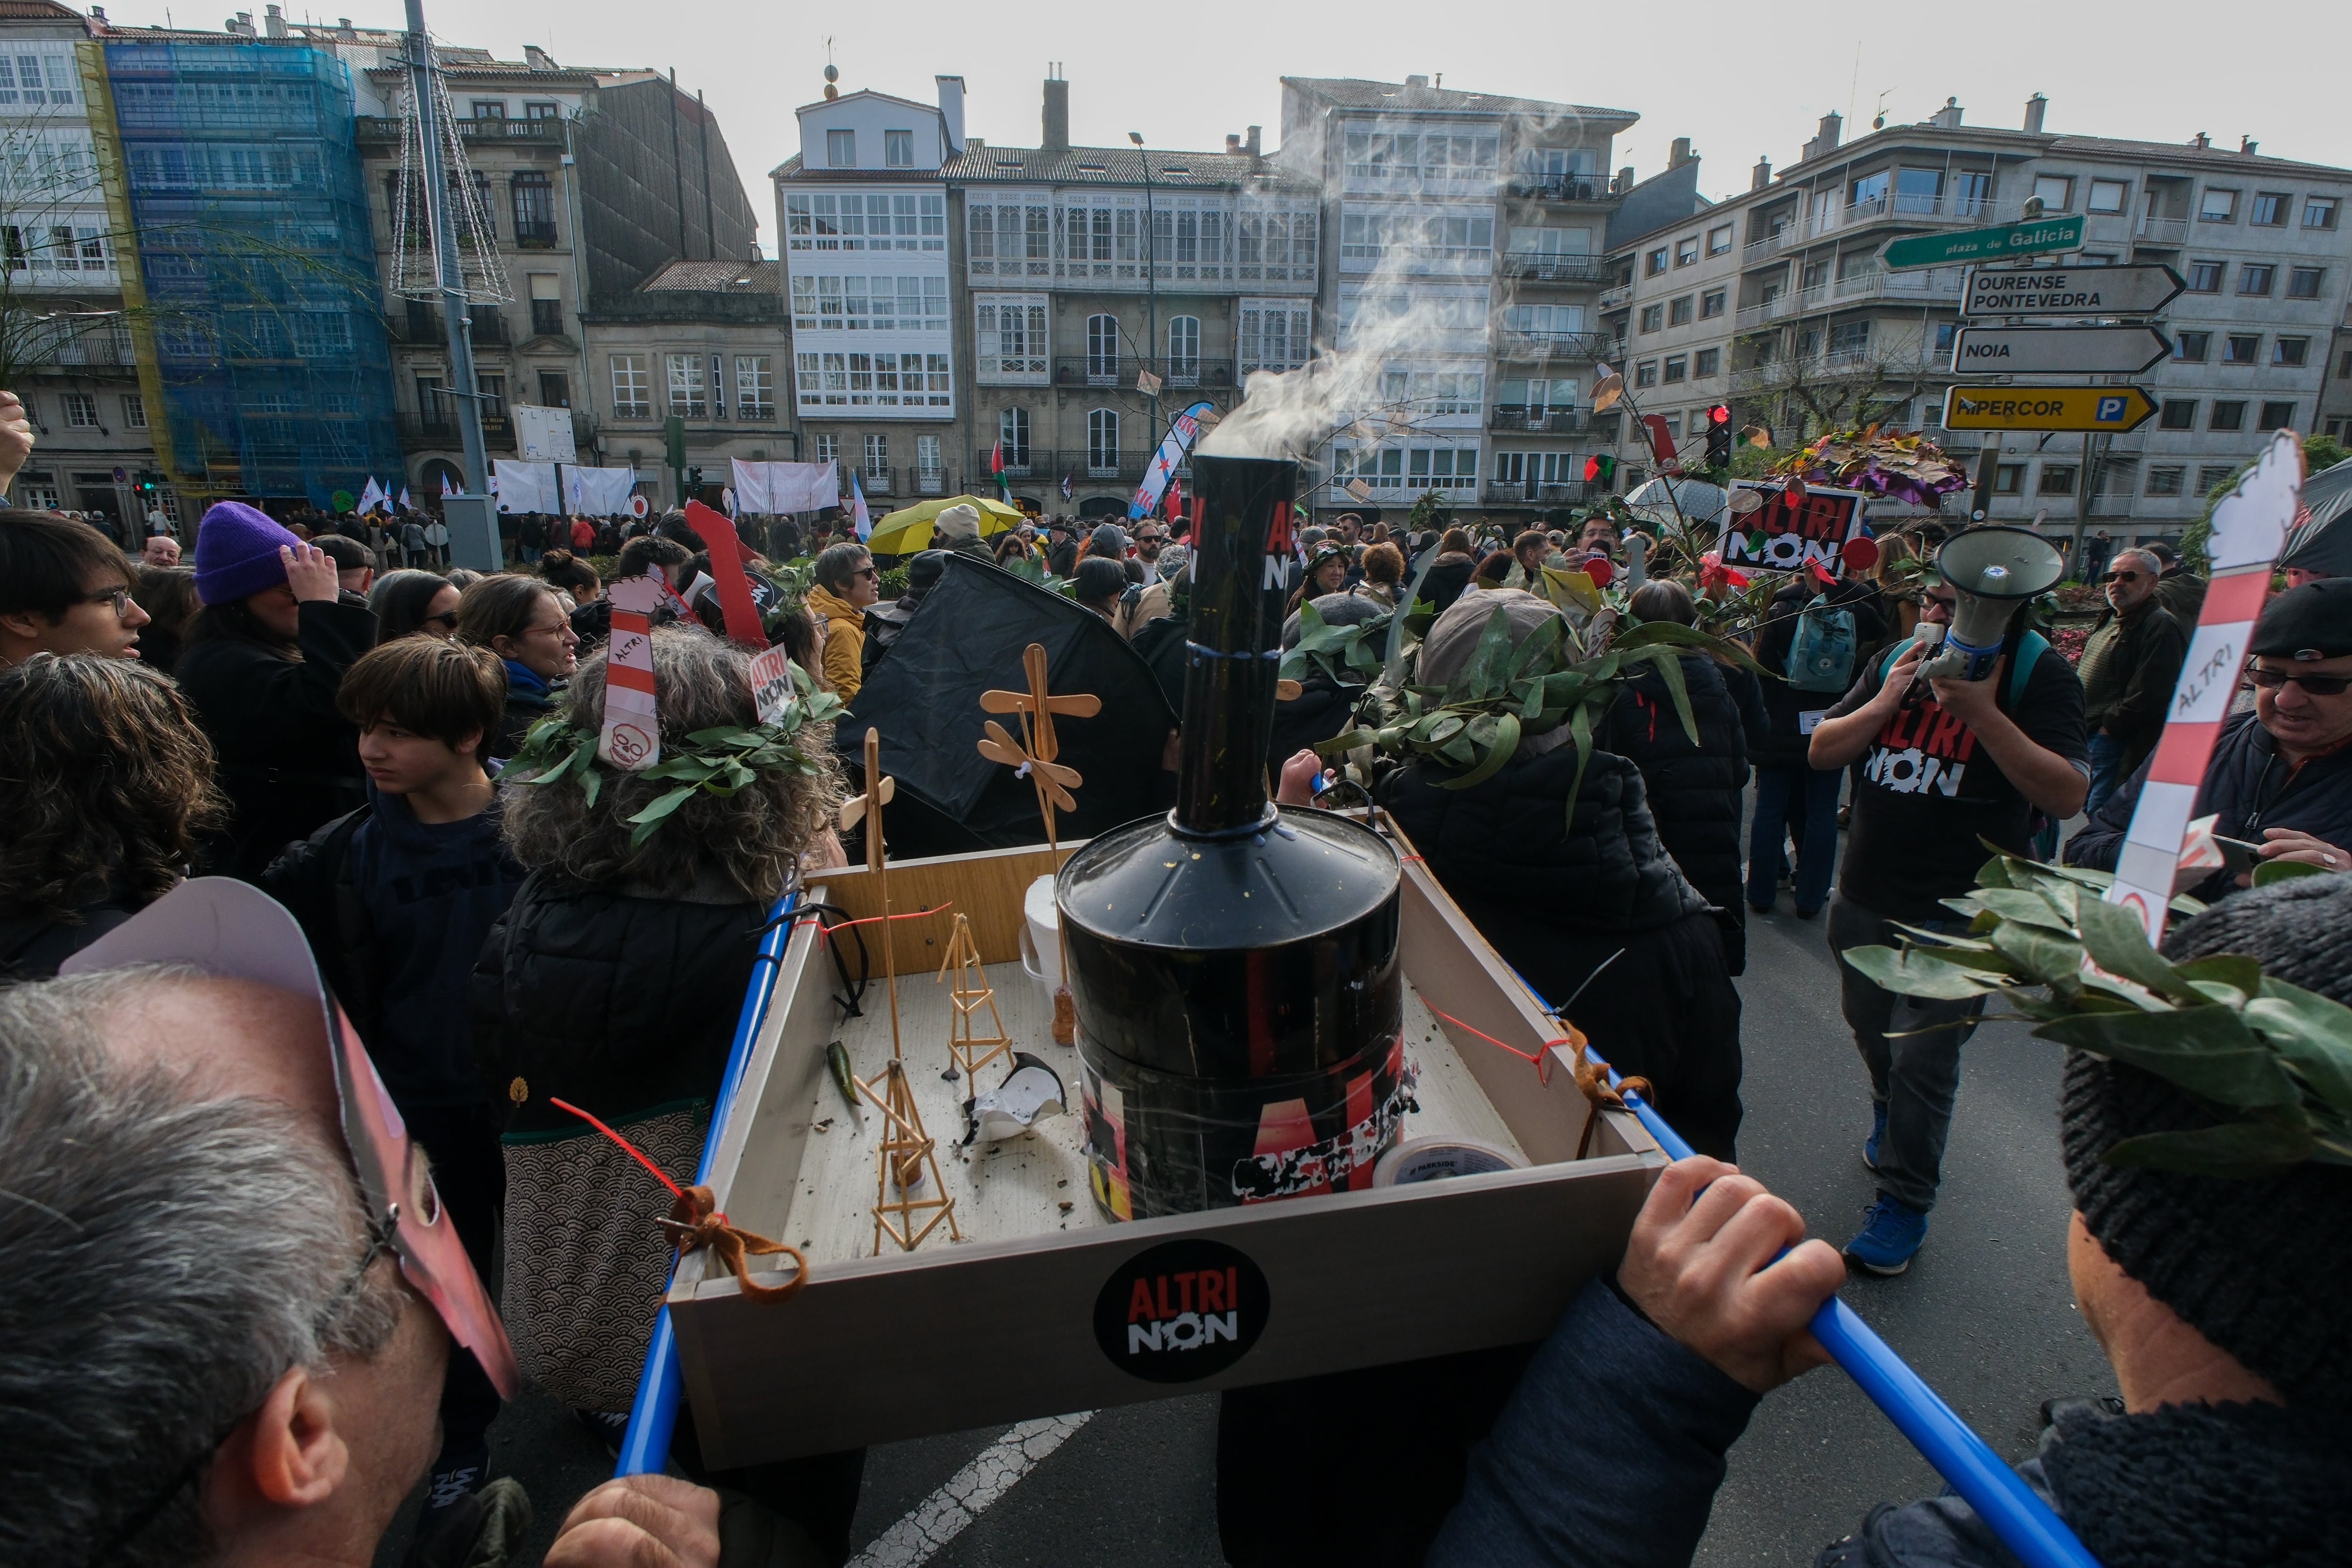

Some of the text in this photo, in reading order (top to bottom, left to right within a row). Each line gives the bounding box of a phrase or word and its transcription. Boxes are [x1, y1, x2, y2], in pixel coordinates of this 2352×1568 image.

[1946, 227, 2075, 255] plaza de Galicia
[1973, 293, 2101, 308] PONTEVEDRA
[1977, 276, 2066, 290] OURENSE
[1965, 344, 2010, 358] NOIA
[1734, 491, 1850, 540] ALTRI
[1727, 531, 1838, 570] NON
[615, 636, 643, 662] ALTRI
[753, 649, 786, 692] ALTRI
[2177, 643, 2232, 716] ALTRI
[756, 675, 790, 711] NON
[1864, 747, 1966, 797] NON
[1128, 1266, 1237, 1323] ALTRI
[1128, 1310, 1238, 1354] NON
